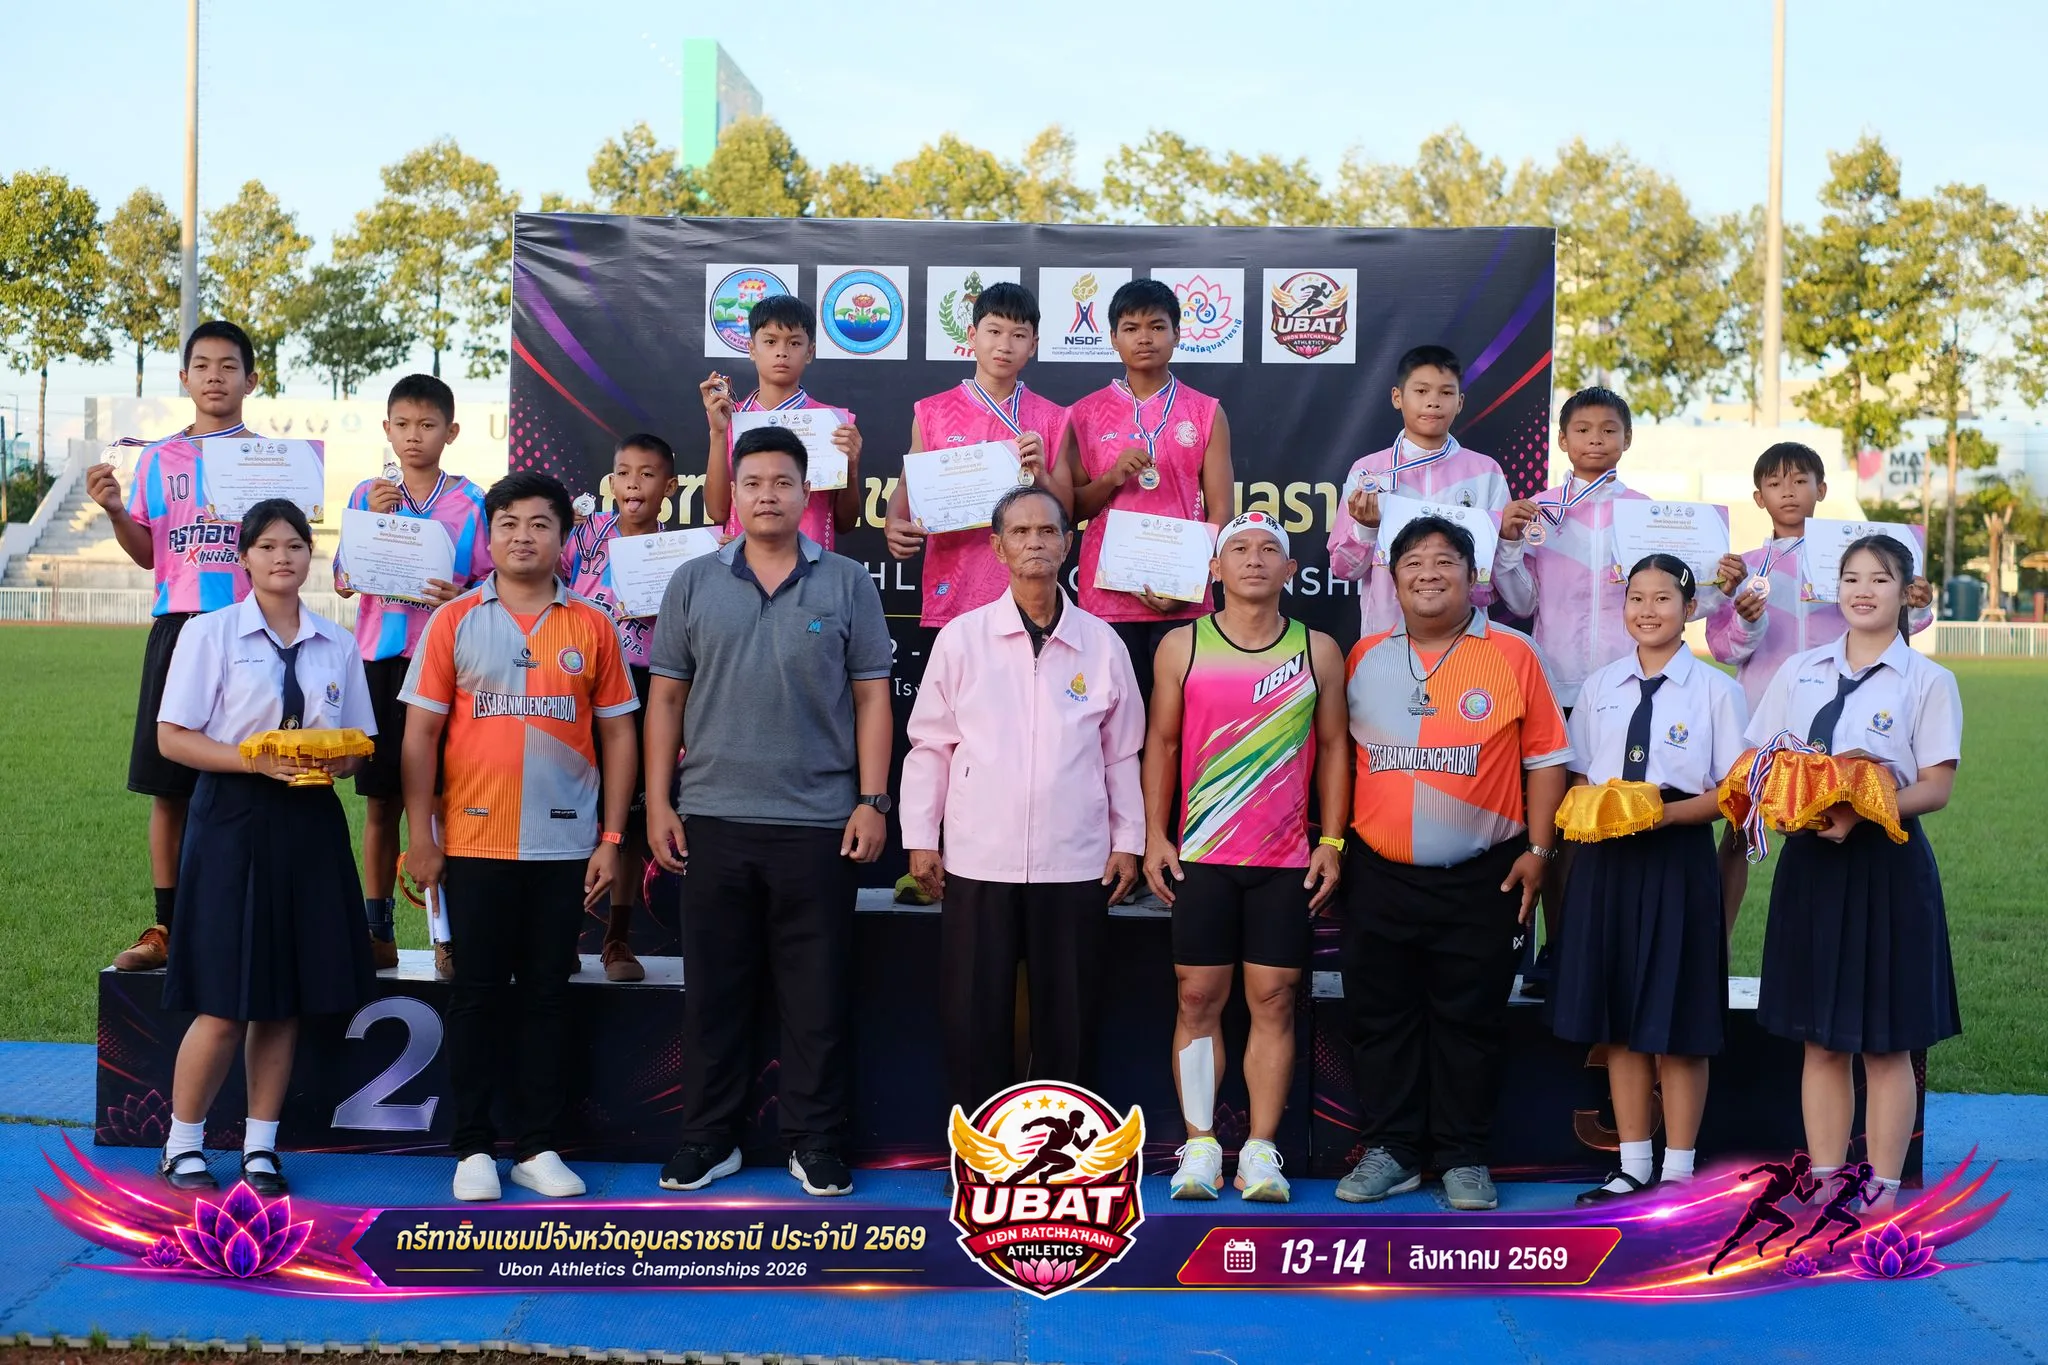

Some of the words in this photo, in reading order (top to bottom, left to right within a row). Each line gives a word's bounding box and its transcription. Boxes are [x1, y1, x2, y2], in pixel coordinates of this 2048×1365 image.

[1277, 317, 1342, 334] UBAT
[1064, 336, 1103, 345] NSDF
[947, 435, 966, 443] CPU
[1101, 432, 1119, 442] CPU
[167, 473, 190, 501] 10
[1252, 652, 1304, 704] UBN
[331, 996, 444, 1131] 2
